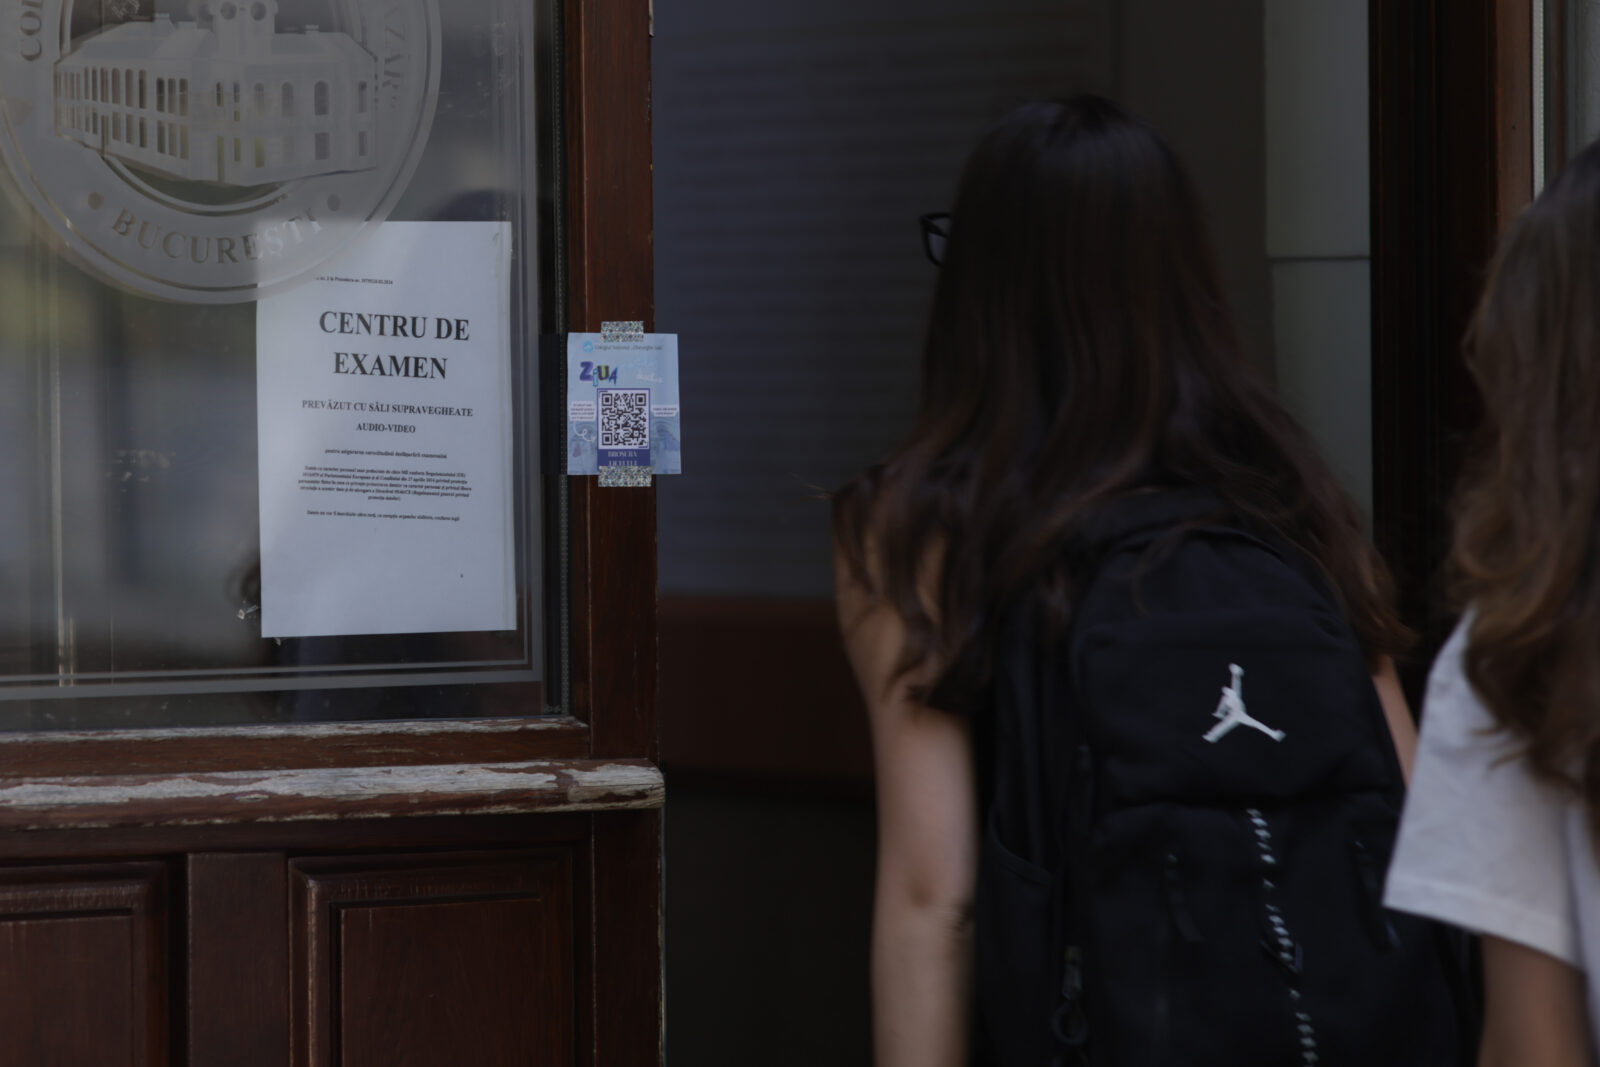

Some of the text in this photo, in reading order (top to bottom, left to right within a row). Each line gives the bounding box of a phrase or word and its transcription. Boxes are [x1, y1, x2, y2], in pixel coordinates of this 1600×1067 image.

[319, 310, 470, 341] CENTRU DE
[333, 352, 448, 380] EXAMEN
[353, 402, 367, 412] CU
[391, 404, 473, 417] SUPRAVEGHEATE
[356, 423, 416, 433] AUDIO-VIDEO
